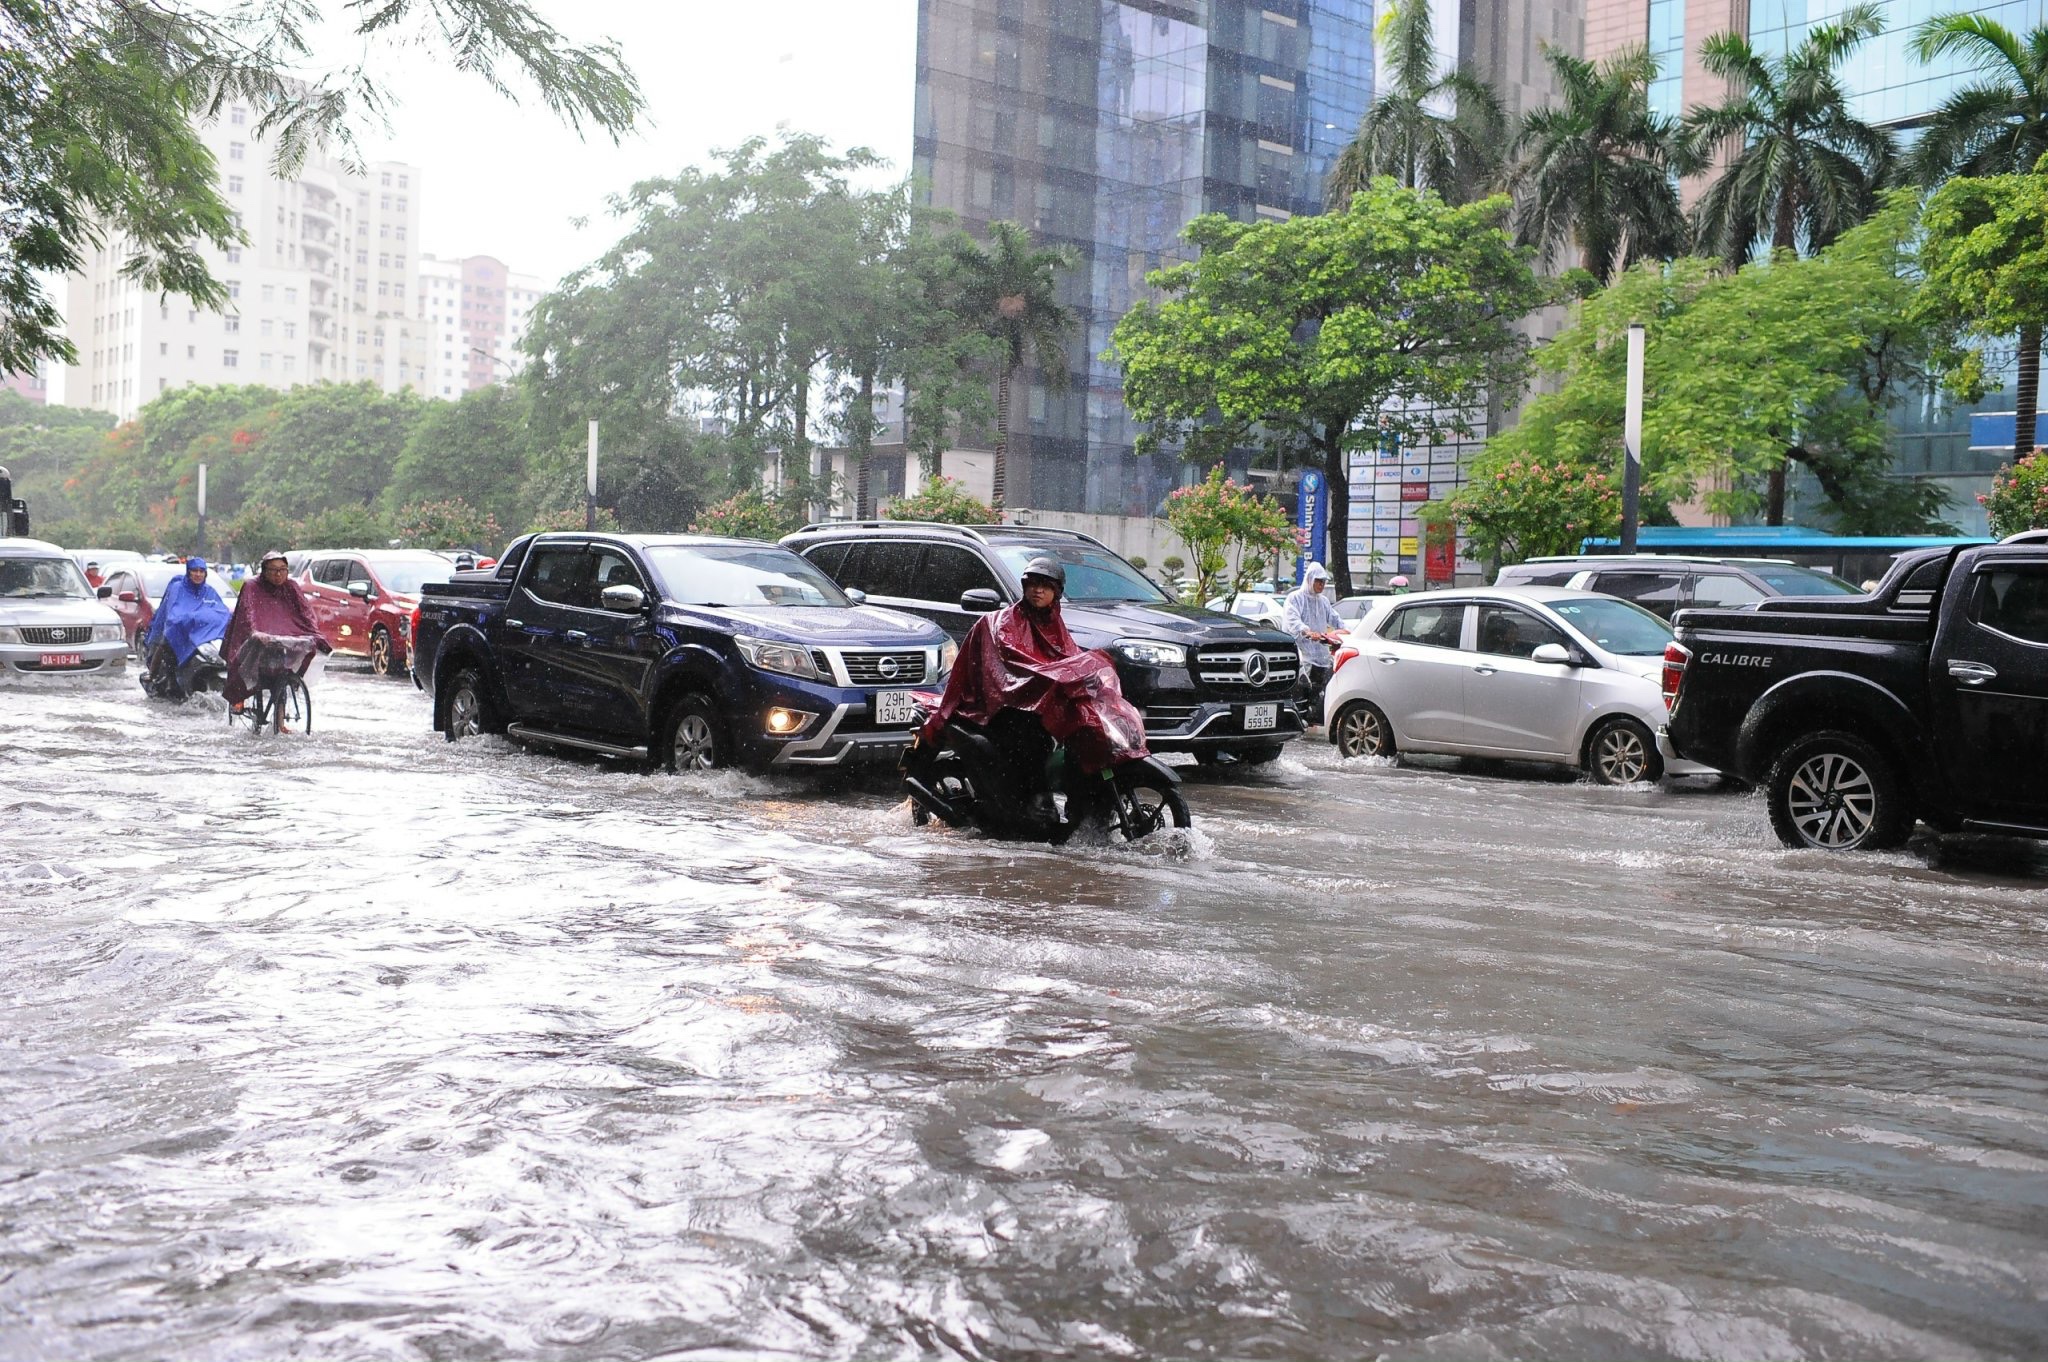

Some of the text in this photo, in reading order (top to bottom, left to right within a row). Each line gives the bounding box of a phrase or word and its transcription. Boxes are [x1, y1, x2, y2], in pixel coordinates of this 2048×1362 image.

[1304, 495, 1315, 548] Shinhan
[1700, 652, 1773, 668] CALIBRE
[885, 692, 905, 706] 29H
[879, 707, 912, 722] 134.57
[1254, 706, 1268, 716] 30H
[1247, 717, 1273, 728] 559.55
